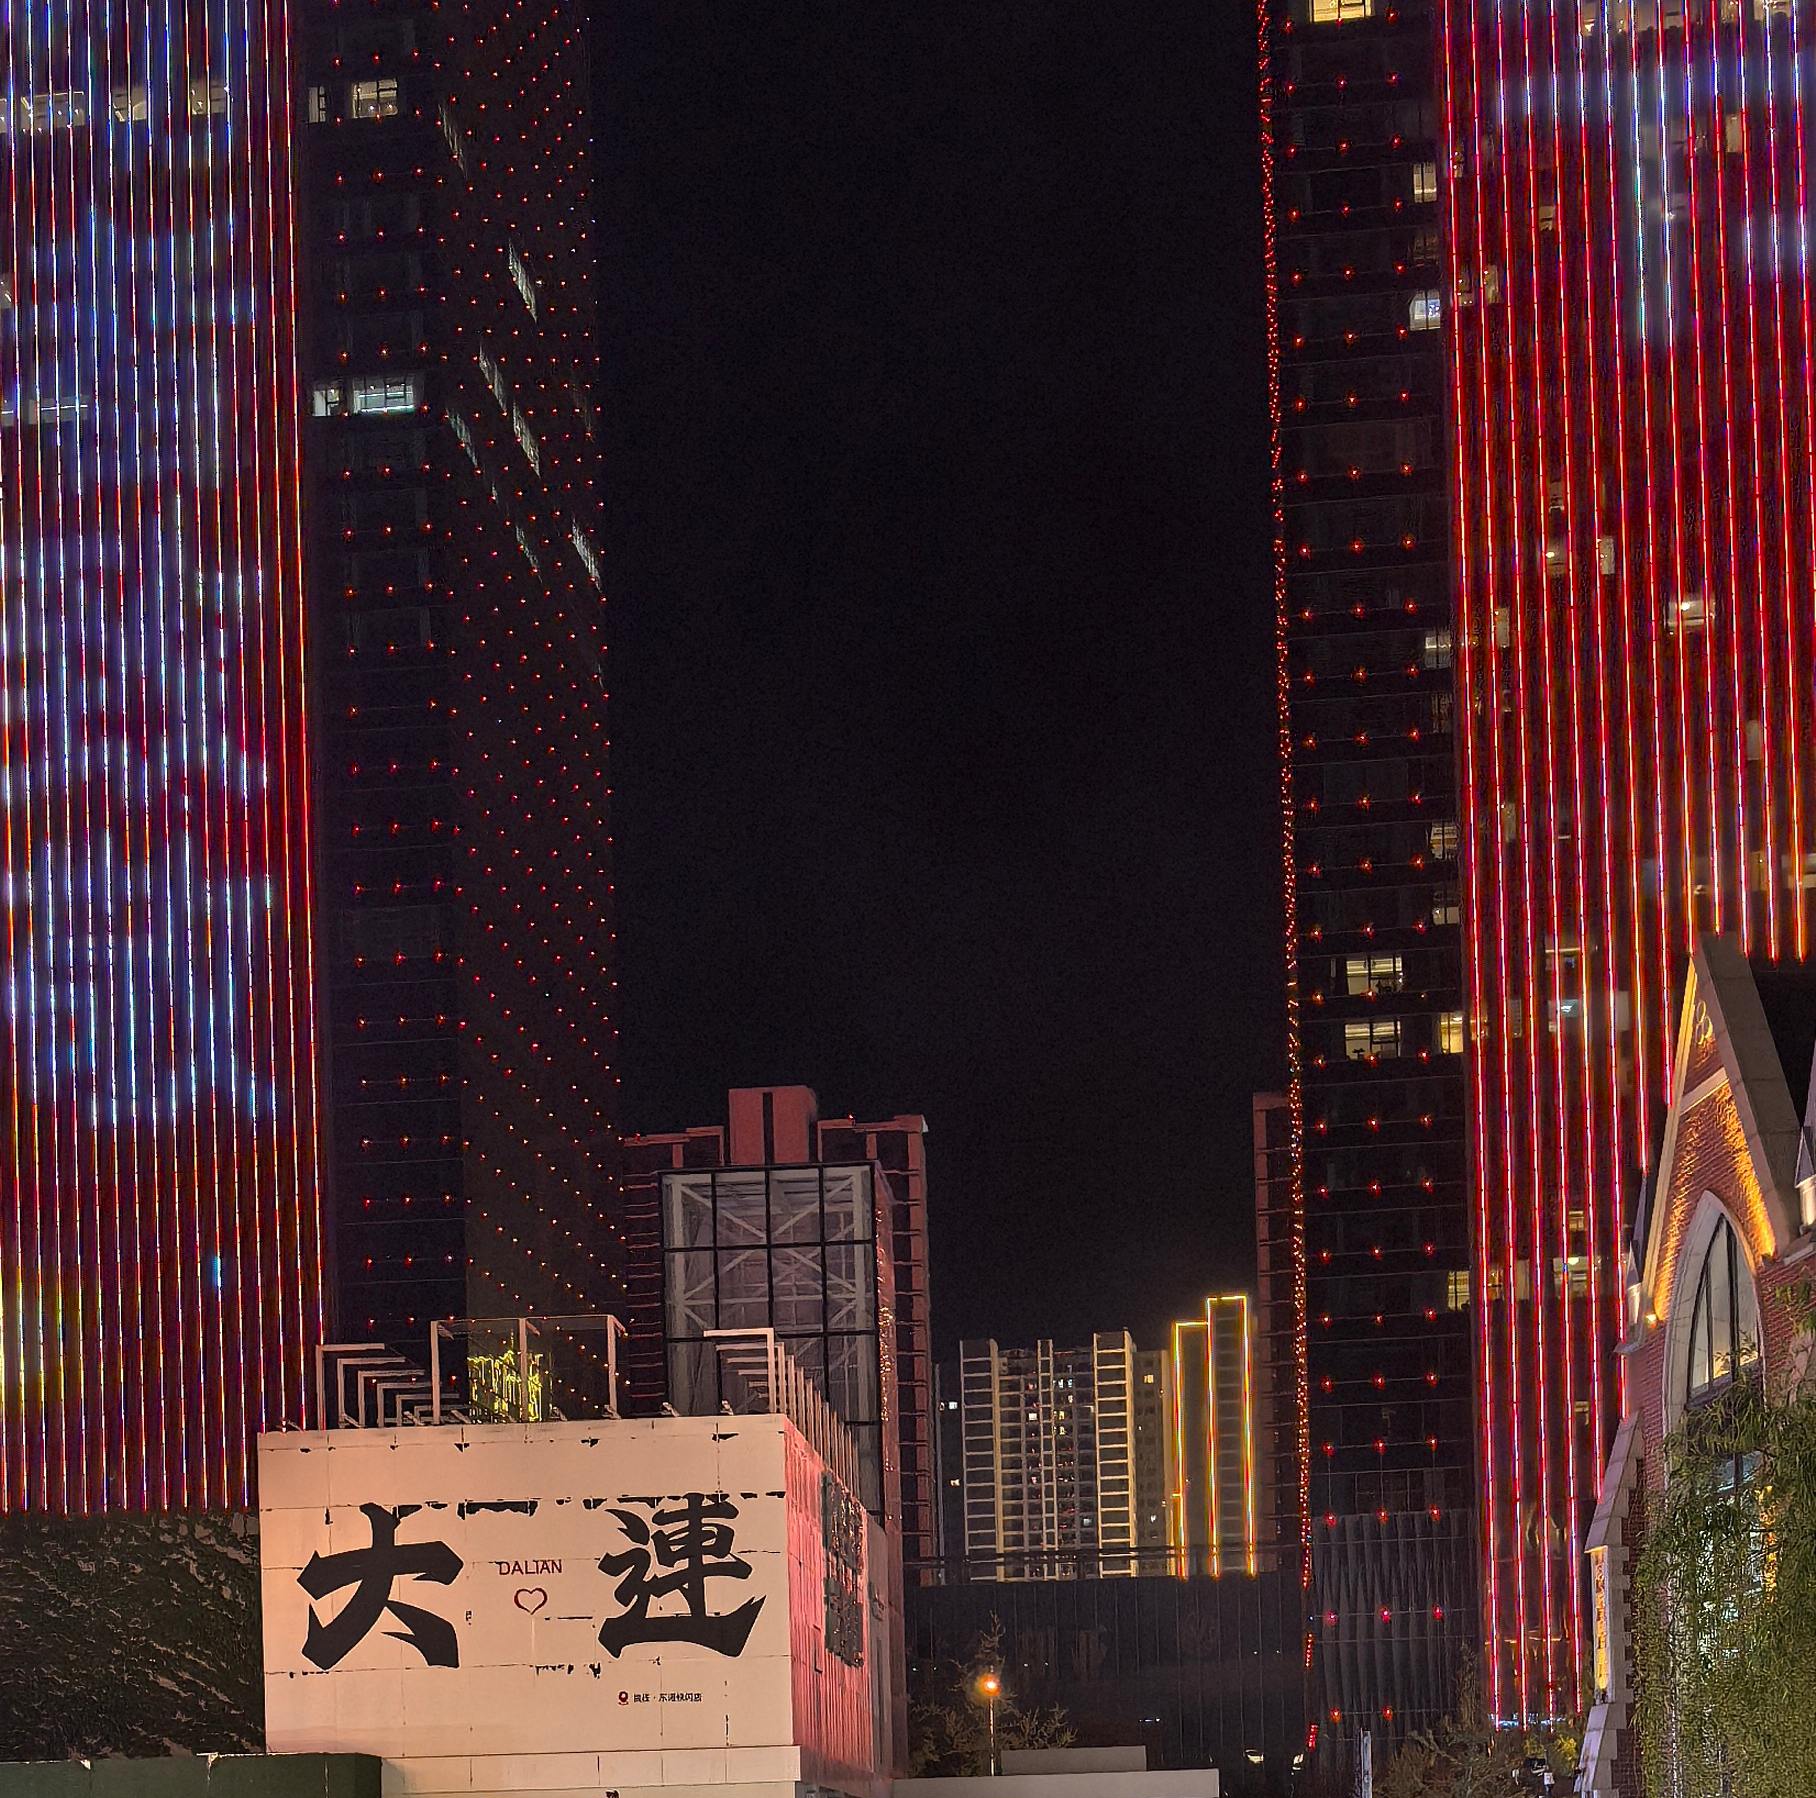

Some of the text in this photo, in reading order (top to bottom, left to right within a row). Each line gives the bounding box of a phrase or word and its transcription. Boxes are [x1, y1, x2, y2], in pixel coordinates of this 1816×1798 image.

[297, 1493, 767, 1670] 大 連
[499, 1559, 562, 1576] DALIAN
